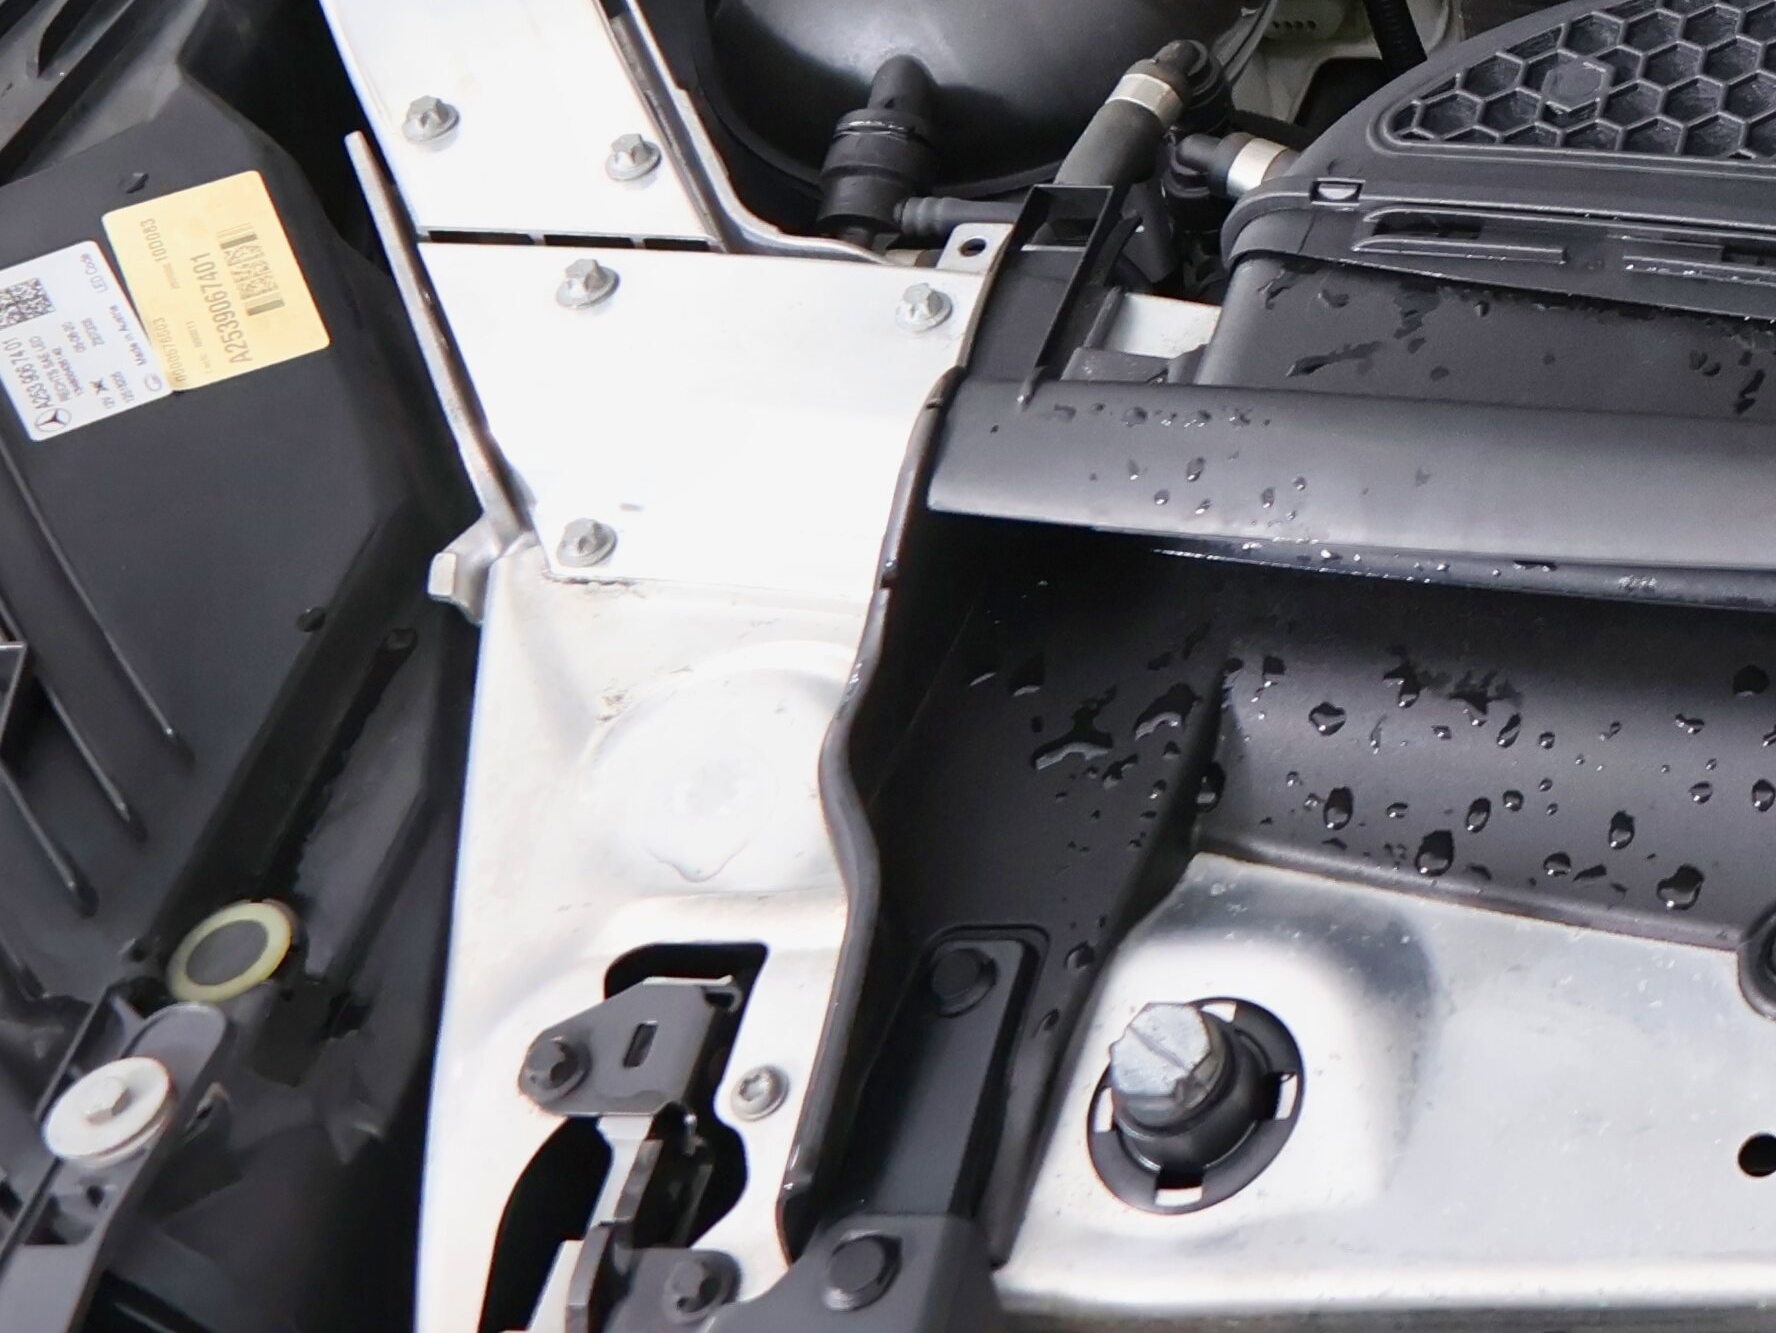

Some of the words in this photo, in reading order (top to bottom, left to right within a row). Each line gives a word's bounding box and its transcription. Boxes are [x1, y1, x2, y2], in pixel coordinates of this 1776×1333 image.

[77, 252, 98, 275] Code
[89, 274, 107, 293] LED
[105, 304, 128, 333] Austria
[188, 251, 253, 365] A2539067401
[2, 336, 22, 350] 01
[28, 335, 45, 352] LED
[8, 349, 28, 364] 74
[126, 342, 147, 366] Made
